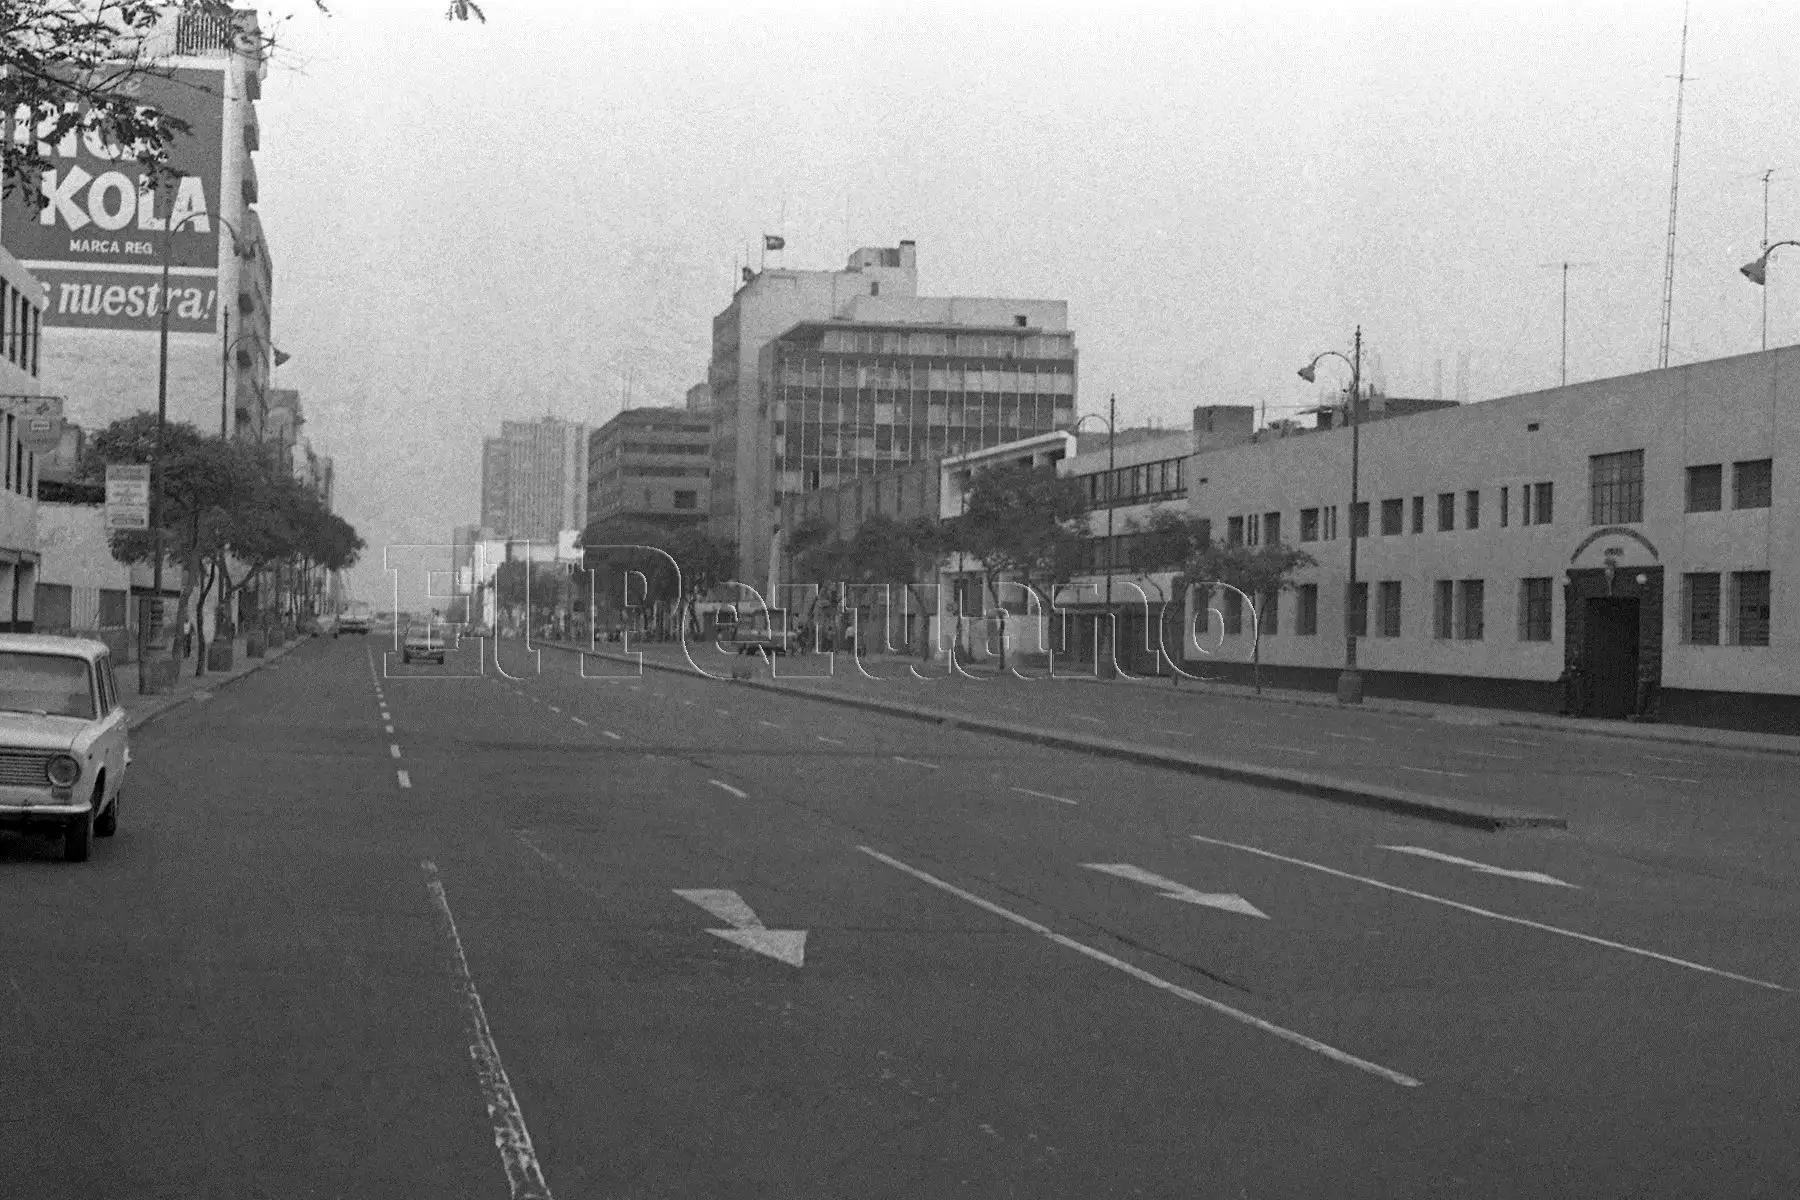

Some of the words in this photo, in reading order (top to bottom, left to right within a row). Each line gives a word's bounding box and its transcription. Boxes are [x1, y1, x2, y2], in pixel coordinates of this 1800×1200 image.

[39, 165, 211, 232] KOLA
[69, 239, 120, 254] MARCA
[57, 282, 216, 319] nuestra!
